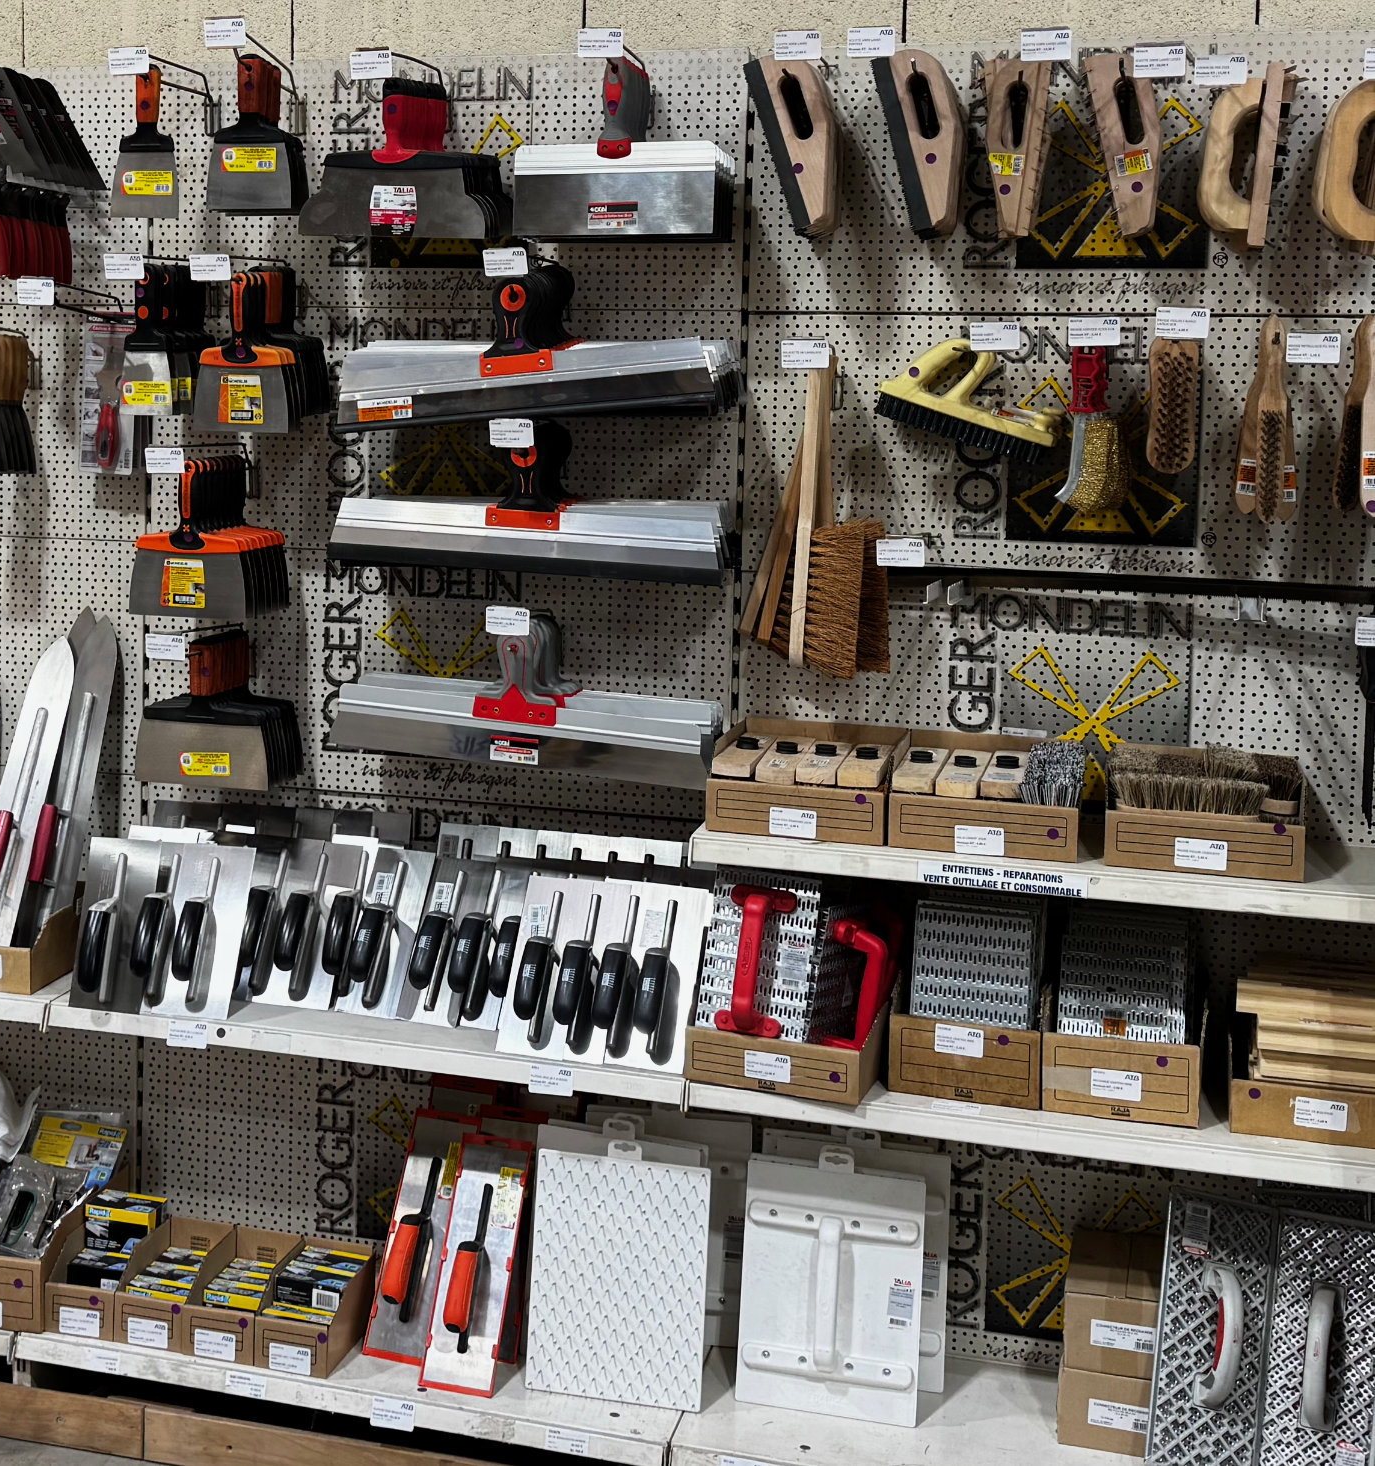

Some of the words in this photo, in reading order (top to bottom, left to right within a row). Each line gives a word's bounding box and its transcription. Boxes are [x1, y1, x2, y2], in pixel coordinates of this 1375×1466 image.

[393, 186, 415, 194] TALIA
[1017, 280, 1089, 294] innove
[1094, 277, 1116, 294] et
[1115, 275, 1208, 308] fabrique
[1007, 552, 1078, 570] innove
[1084, 552, 1107, 570] et
[1107, 551, 1196, 577] fabrique
[325, 559, 521, 602] MONDELIN
[949, 592, 1195, 639] MONDELIN
[942, 864, 994, 877] ENTRETIENS
[1003, 870, 1063, 884] REPARATIONS
[923, 874, 950, 884] VENTE
[952, 877, 998, 890] OUTILLAGE
[1000, 882, 1012, 890] ET
[1013, 882, 1082, 897] CONSOMMABLE
[757, 1080, 776, 1088] RAJA
[953, 1088, 973, 1096] RAJA
[99, 1128, 116, 1138] Rapid
[315, 1079, 355, 1236] ROGER
[89, 1207, 105, 1217] Rapid
[923, 1250, 937, 1258] ALIA
[893, 1277, 912, 1286] TALIA
[207, 1293, 224, 1303] Rapid
